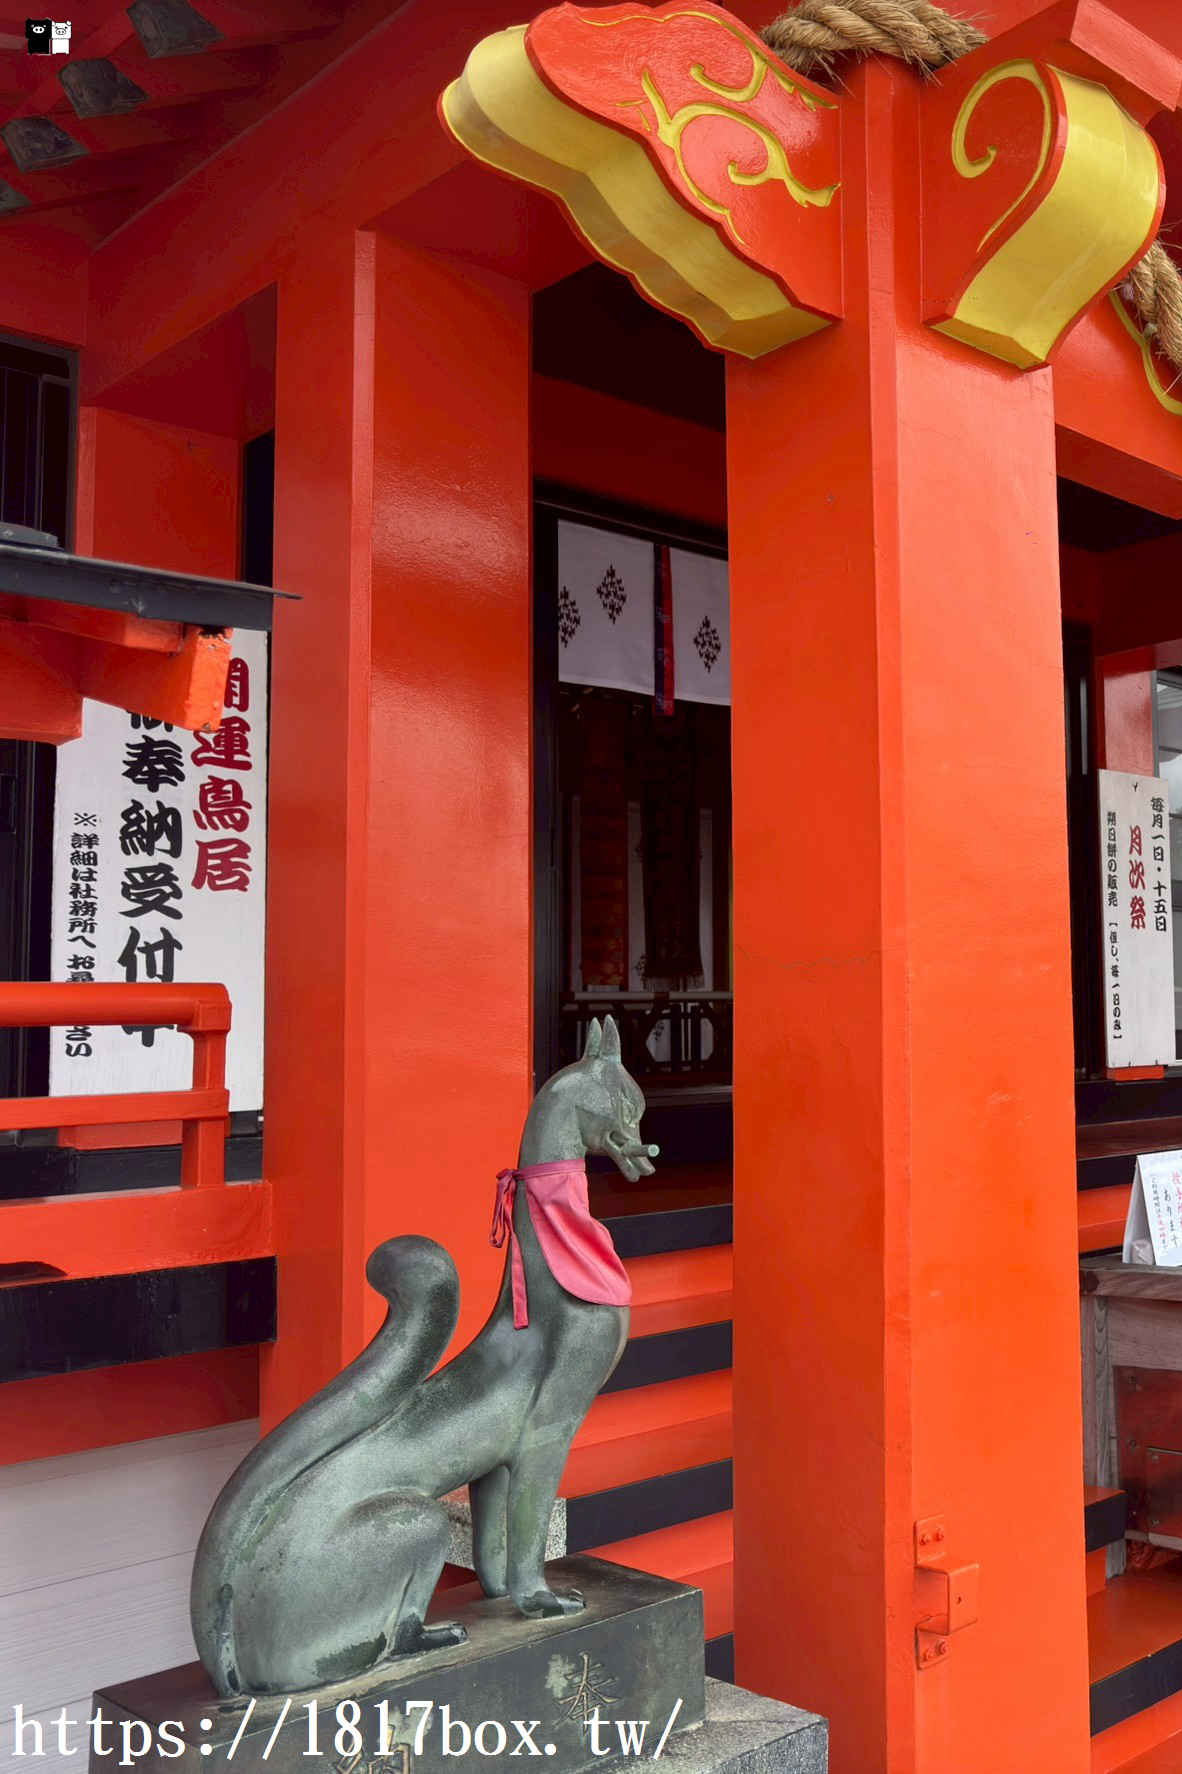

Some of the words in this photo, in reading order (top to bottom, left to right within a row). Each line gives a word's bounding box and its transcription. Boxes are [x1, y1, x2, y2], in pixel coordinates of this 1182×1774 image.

[117, 710, 187, 1048] 奉納受付
[1128, 824, 1146, 930] 月次祭
